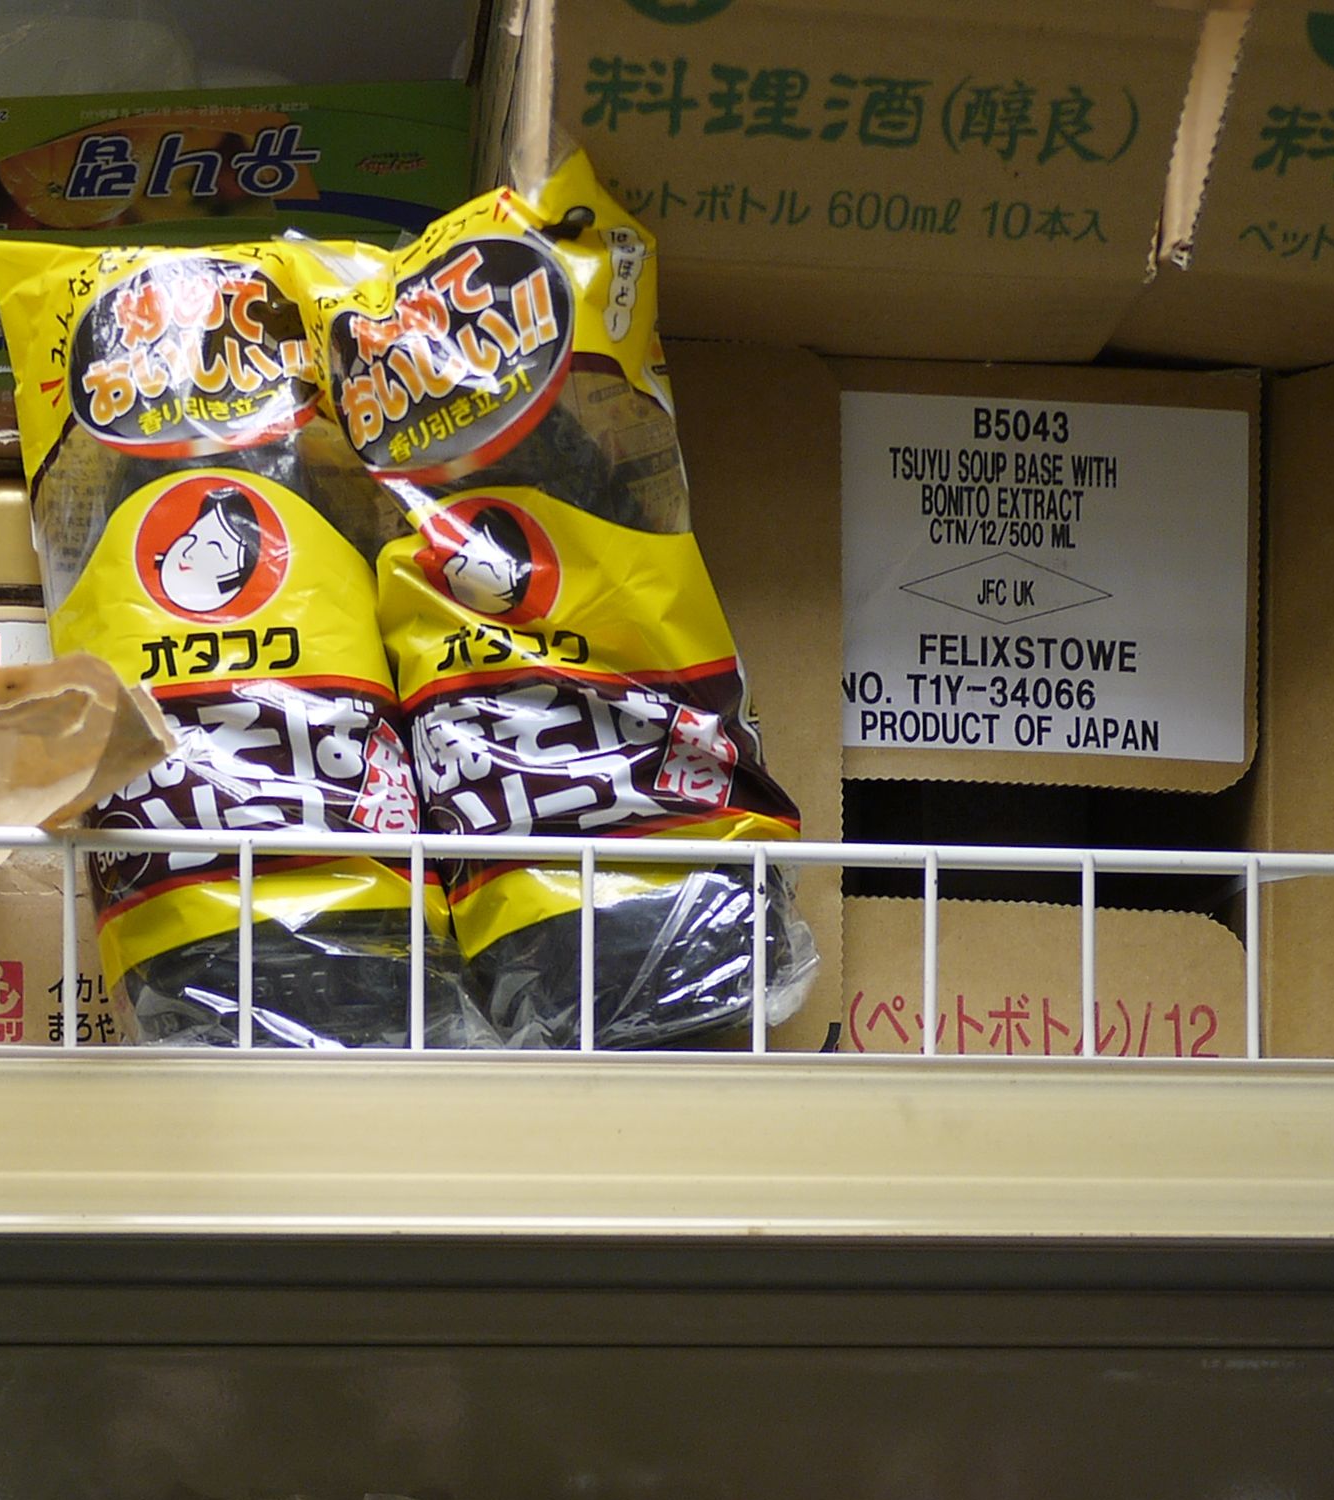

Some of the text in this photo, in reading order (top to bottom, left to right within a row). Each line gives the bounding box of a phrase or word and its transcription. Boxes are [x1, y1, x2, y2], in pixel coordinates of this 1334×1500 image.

[974, 408, 1069, 443] B5043
[890, 447, 1117, 487] TSUYU SOUP BASE WITH
[922, 484, 1084, 521] BONITO EXTRACT
[930, 519, 1076, 549] CTN/12/500 ML
[977, 579, 1035, 606] JFC UK
[141, 627, 299, 680] オタフク
[919, 634, 1137, 673] FELIXSTOWE
[841, 672, 1096, 710] NO. T1Y-34066
[861, 710, 1159, 751] PRODUCT OF JAPAN
